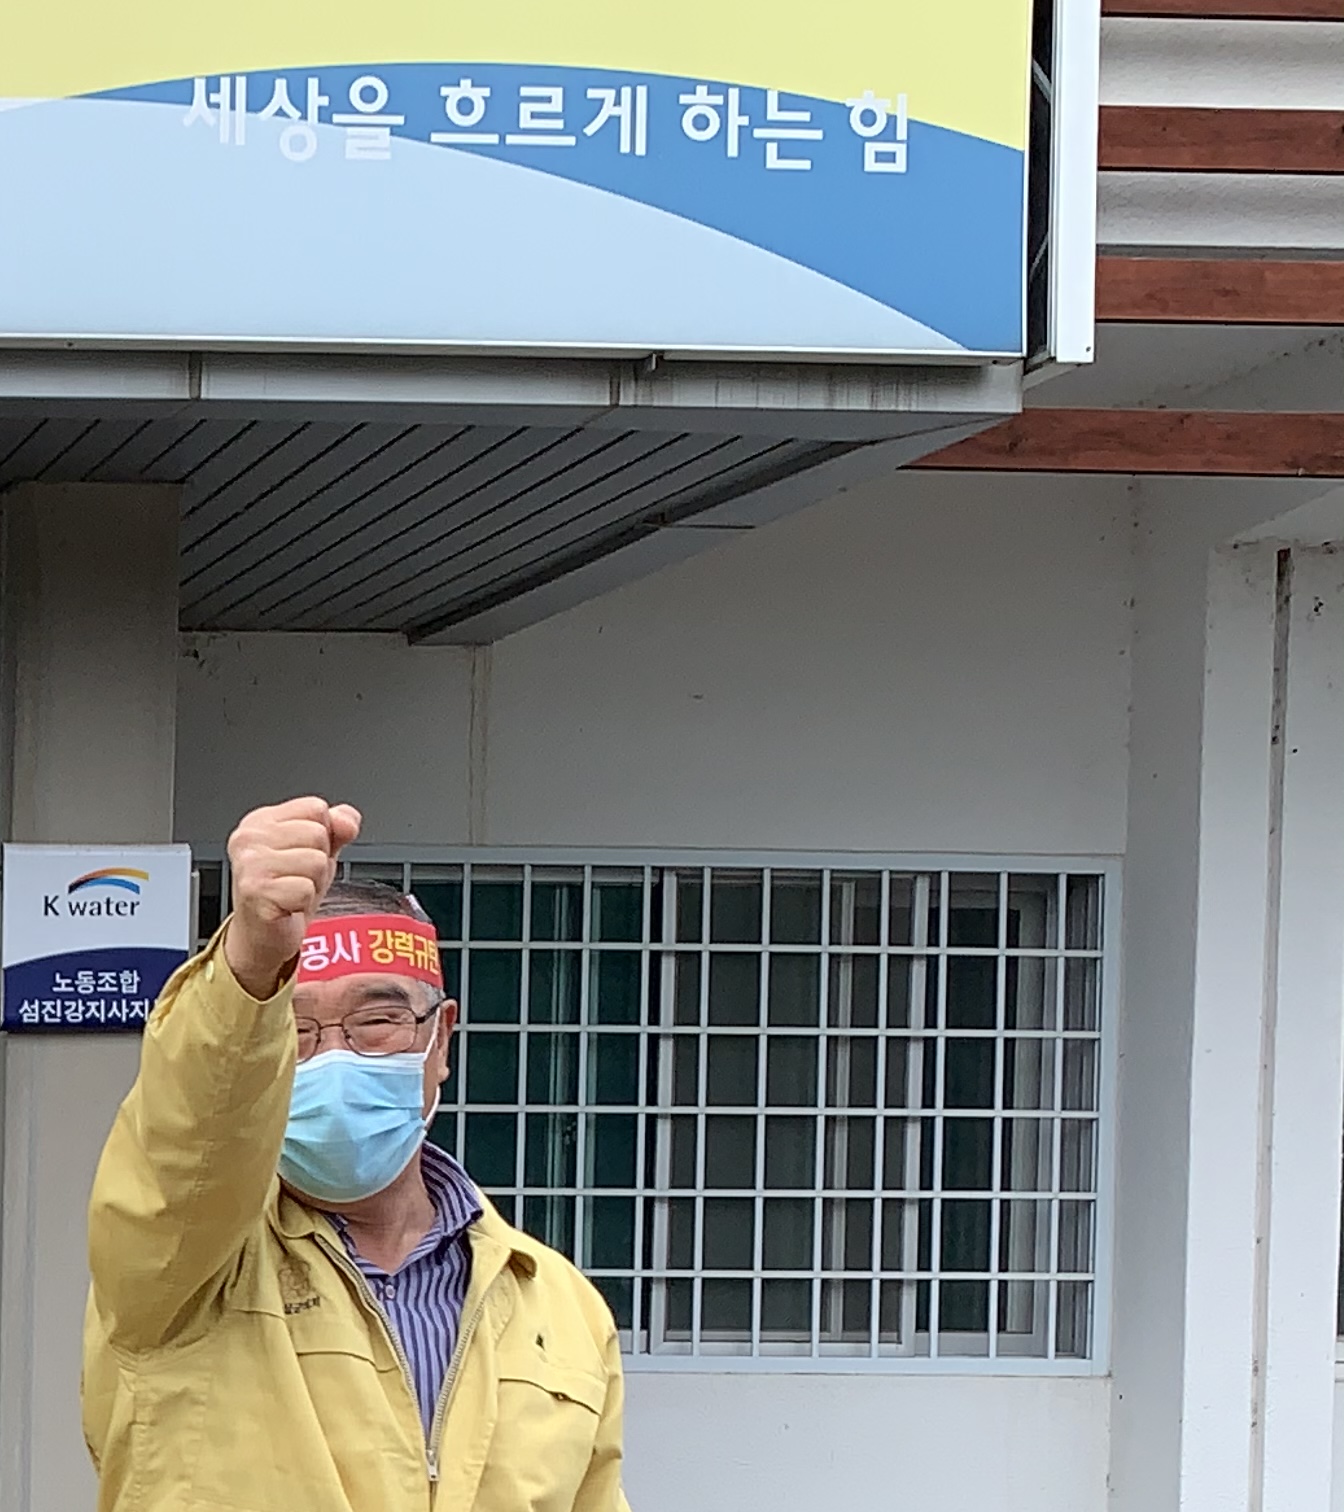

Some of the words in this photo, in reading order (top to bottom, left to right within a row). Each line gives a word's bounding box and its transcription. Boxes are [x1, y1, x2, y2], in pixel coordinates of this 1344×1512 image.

[180, 75, 405, 161] 세상을
[430, 79, 648, 156] 흐르게
[678, 84, 823, 171] 하는
[845, 89, 910, 174] 힘
[45, 896, 59, 916] K
[68, 897, 140, 917] water
[52, 970, 141, 994] 노동조합
[18, 998, 160, 1024] 섬진강지사지
